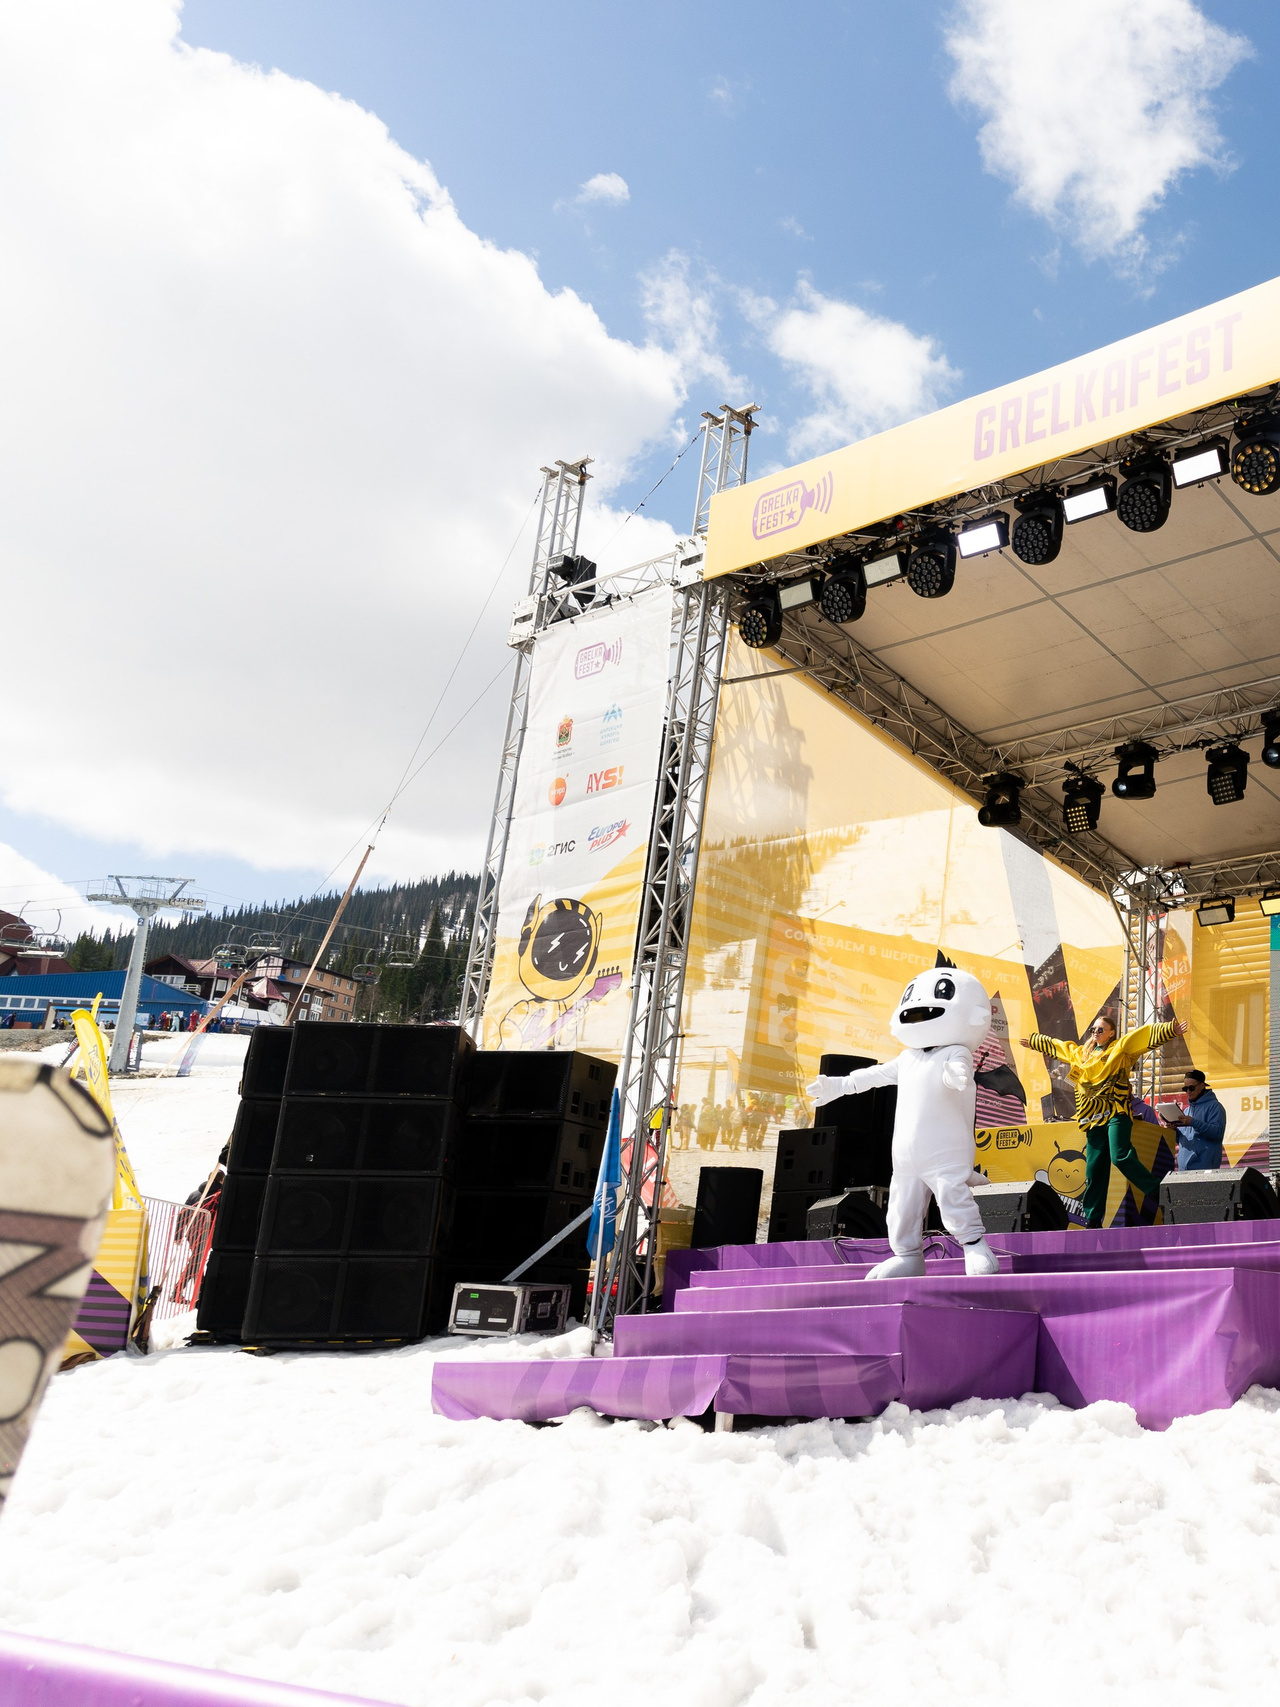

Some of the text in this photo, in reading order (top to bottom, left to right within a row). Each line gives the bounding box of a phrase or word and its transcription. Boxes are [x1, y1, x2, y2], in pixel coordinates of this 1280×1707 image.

[973, 311, 1243, 462] GRELKAFEST
[760, 488, 799, 515] GRELKA
[759, 509, 786, 533] FEST
[580, 646, 603, 663] GRELKA
[579, 660, 595, 675] FEST
[586, 765, 624, 794] AYS!
[547, 840, 576, 857] 2ГИС
[785, 928, 865, 953] СОГРЕВАЕМ
[869, 944, 877, 956] В
[980, 969, 991, 980] 10
[995, 973, 1020, 985] ЛЕТ!
[1000, 1131, 1018, 1139] GRELKA
